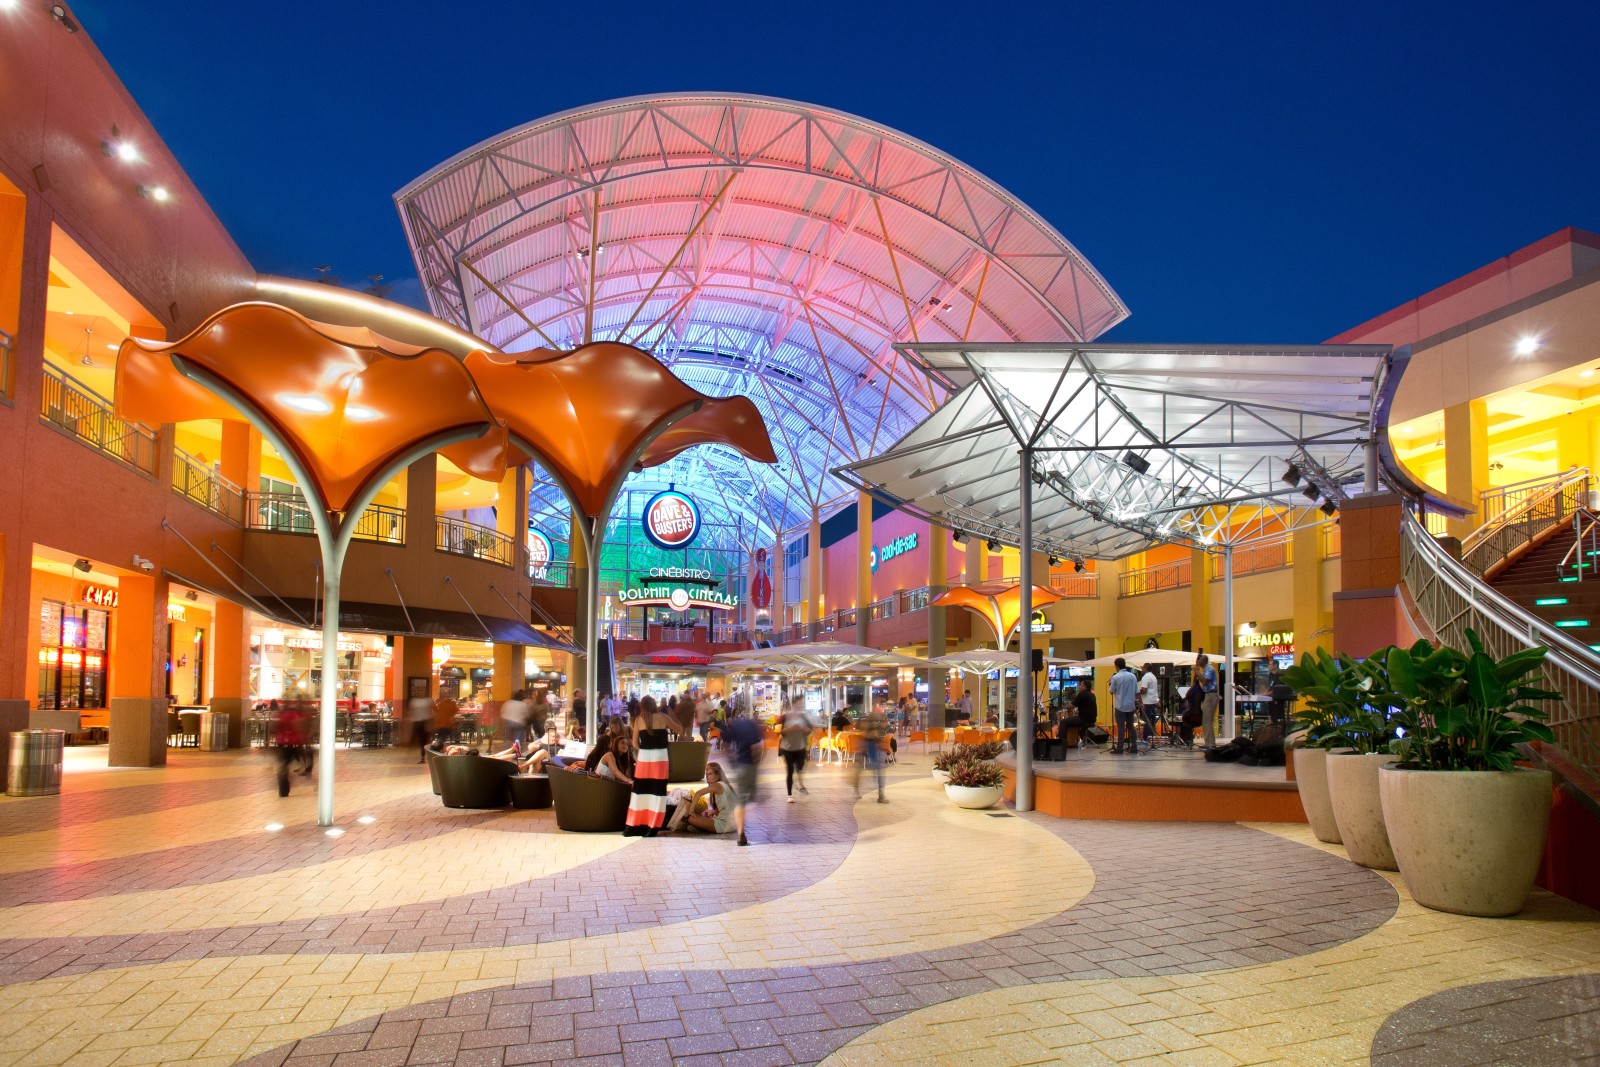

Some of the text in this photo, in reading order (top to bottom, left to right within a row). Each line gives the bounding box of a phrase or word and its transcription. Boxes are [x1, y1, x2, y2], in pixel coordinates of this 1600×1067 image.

[653, 505, 691, 522] DAVE &
[654, 517, 693, 535] BUSTER'S
[881, 532, 918, 562] cool-de-sac
[529, 566, 547, 580] PLAY
[649, 565, 711, 580] CINÉBISTRO
[618, 587, 670, 602] DOLPHIN
[688, 588, 738, 606] CINEMAS
[292, 638, 362, 652] HAMBGERS
[1238, 632, 1295, 648] BUFFALO W
